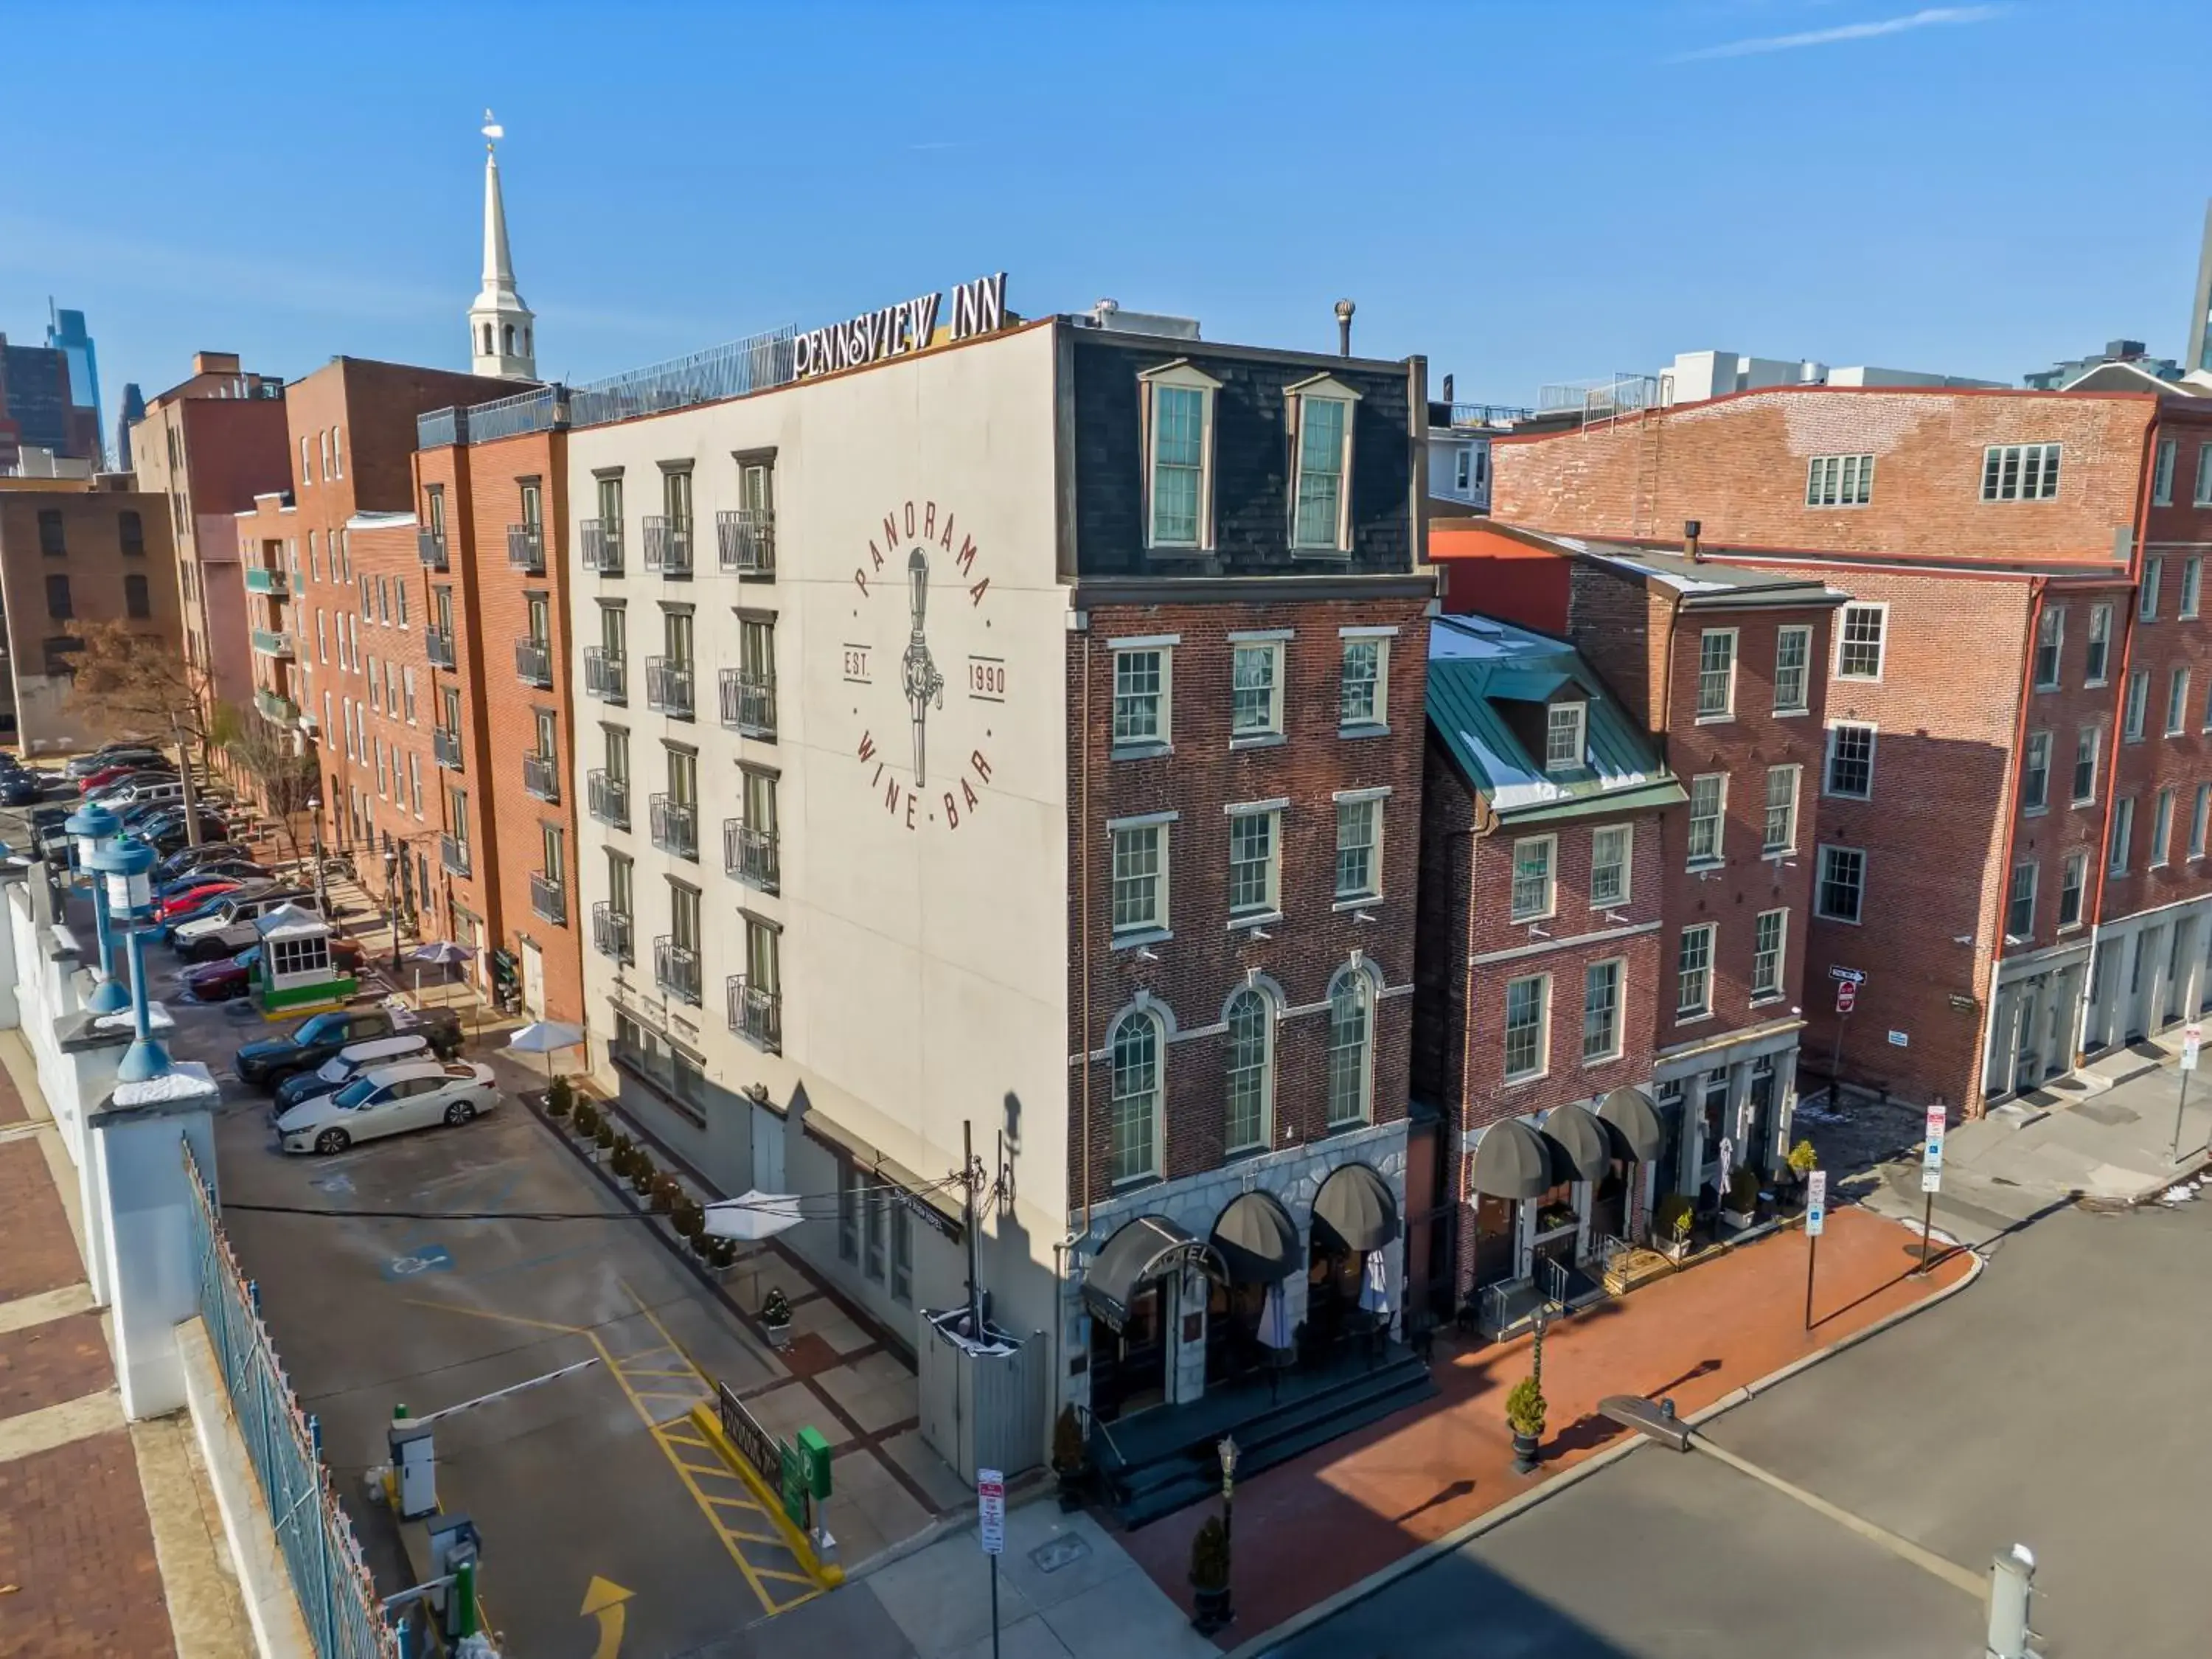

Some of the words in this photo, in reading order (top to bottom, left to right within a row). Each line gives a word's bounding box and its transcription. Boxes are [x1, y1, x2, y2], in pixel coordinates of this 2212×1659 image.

[792, 292, 942, 380] PENNSVIEW
[950, 272, 1008, 341] INN
[855, 501, 990, 608] PANORAMA
[969, 664, 1004, 693] 1990
[858, 730, 916, 831] WINE
[944, 749, 992, 830] BAR
